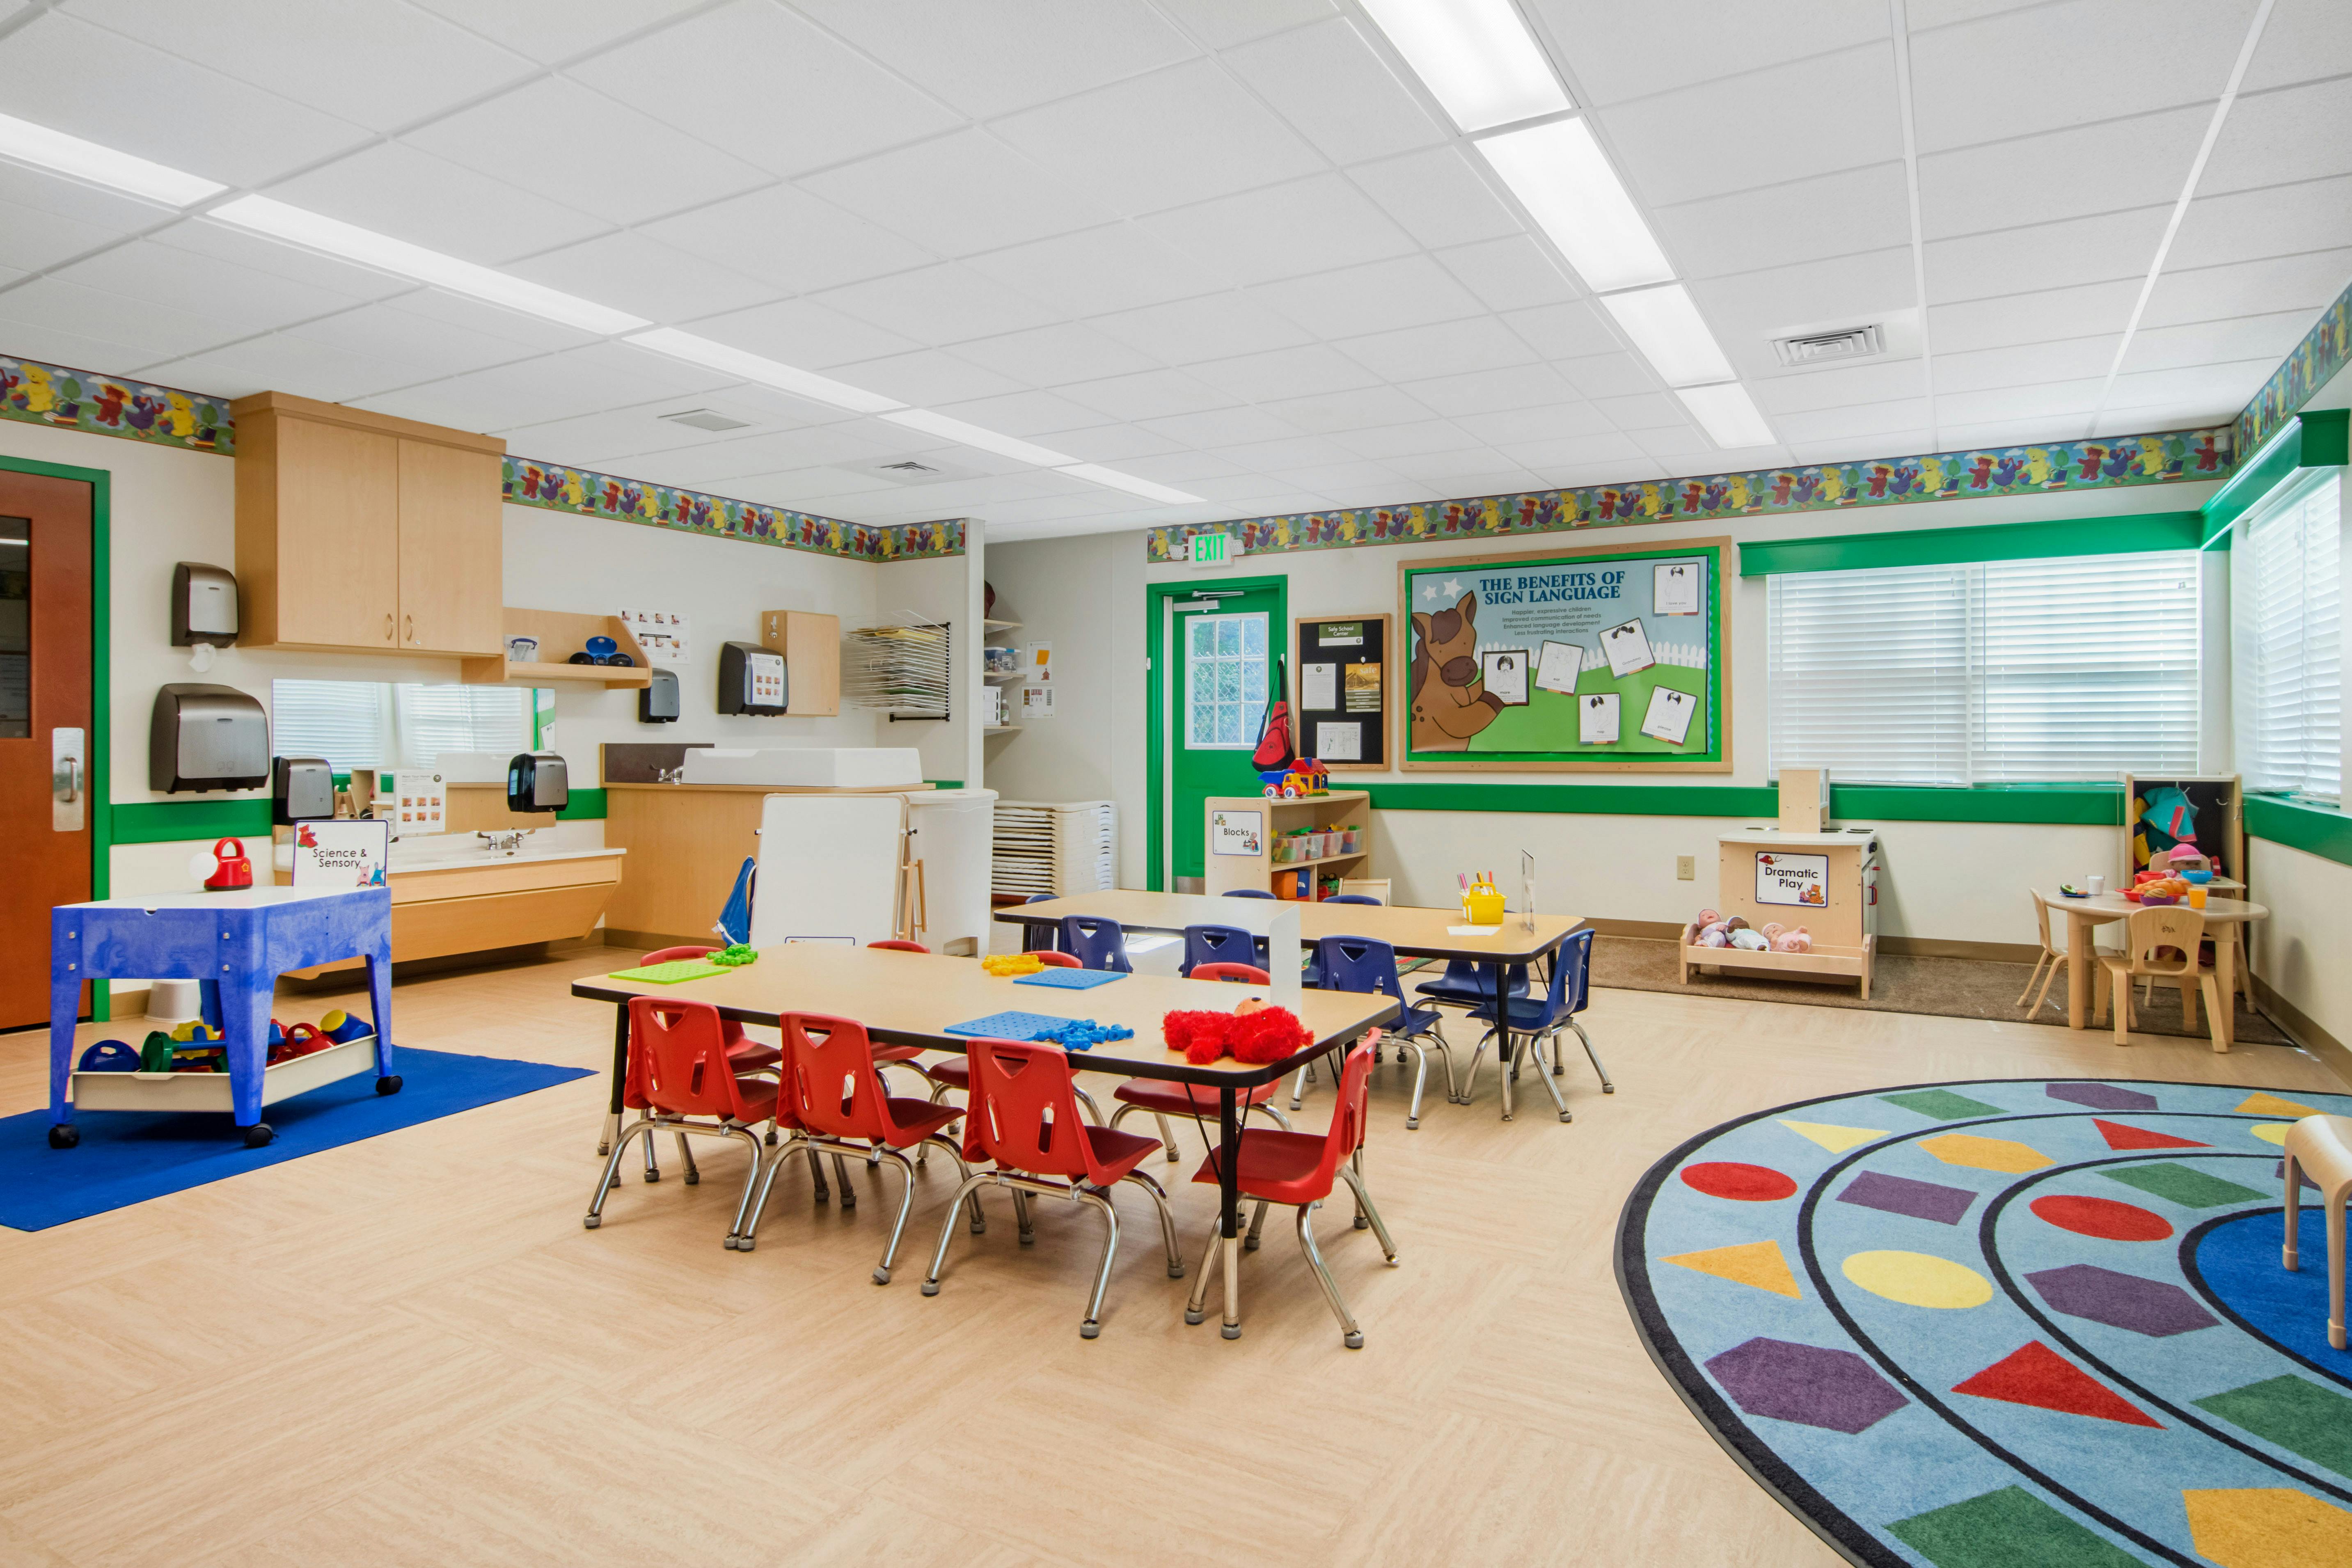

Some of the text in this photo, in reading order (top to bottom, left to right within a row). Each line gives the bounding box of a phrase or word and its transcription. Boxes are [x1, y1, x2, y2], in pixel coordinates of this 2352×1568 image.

[1195, 534, 1225, 561] EXIT
[1480, 571, 1625, 591] THE BENEFITS OF
[1485, 586, 1620, 604] SIGN LANGUAGE
[1622, 656, 1641, 666] Grandma
[1359, 666, 1377, 674] safe
[313, 849, 367, 857] Science &
[319, 858, 361, 869] Sensory
[1765, 867, 1818, 878] Dramatic
[1779, 879, 1803, 890] Play
